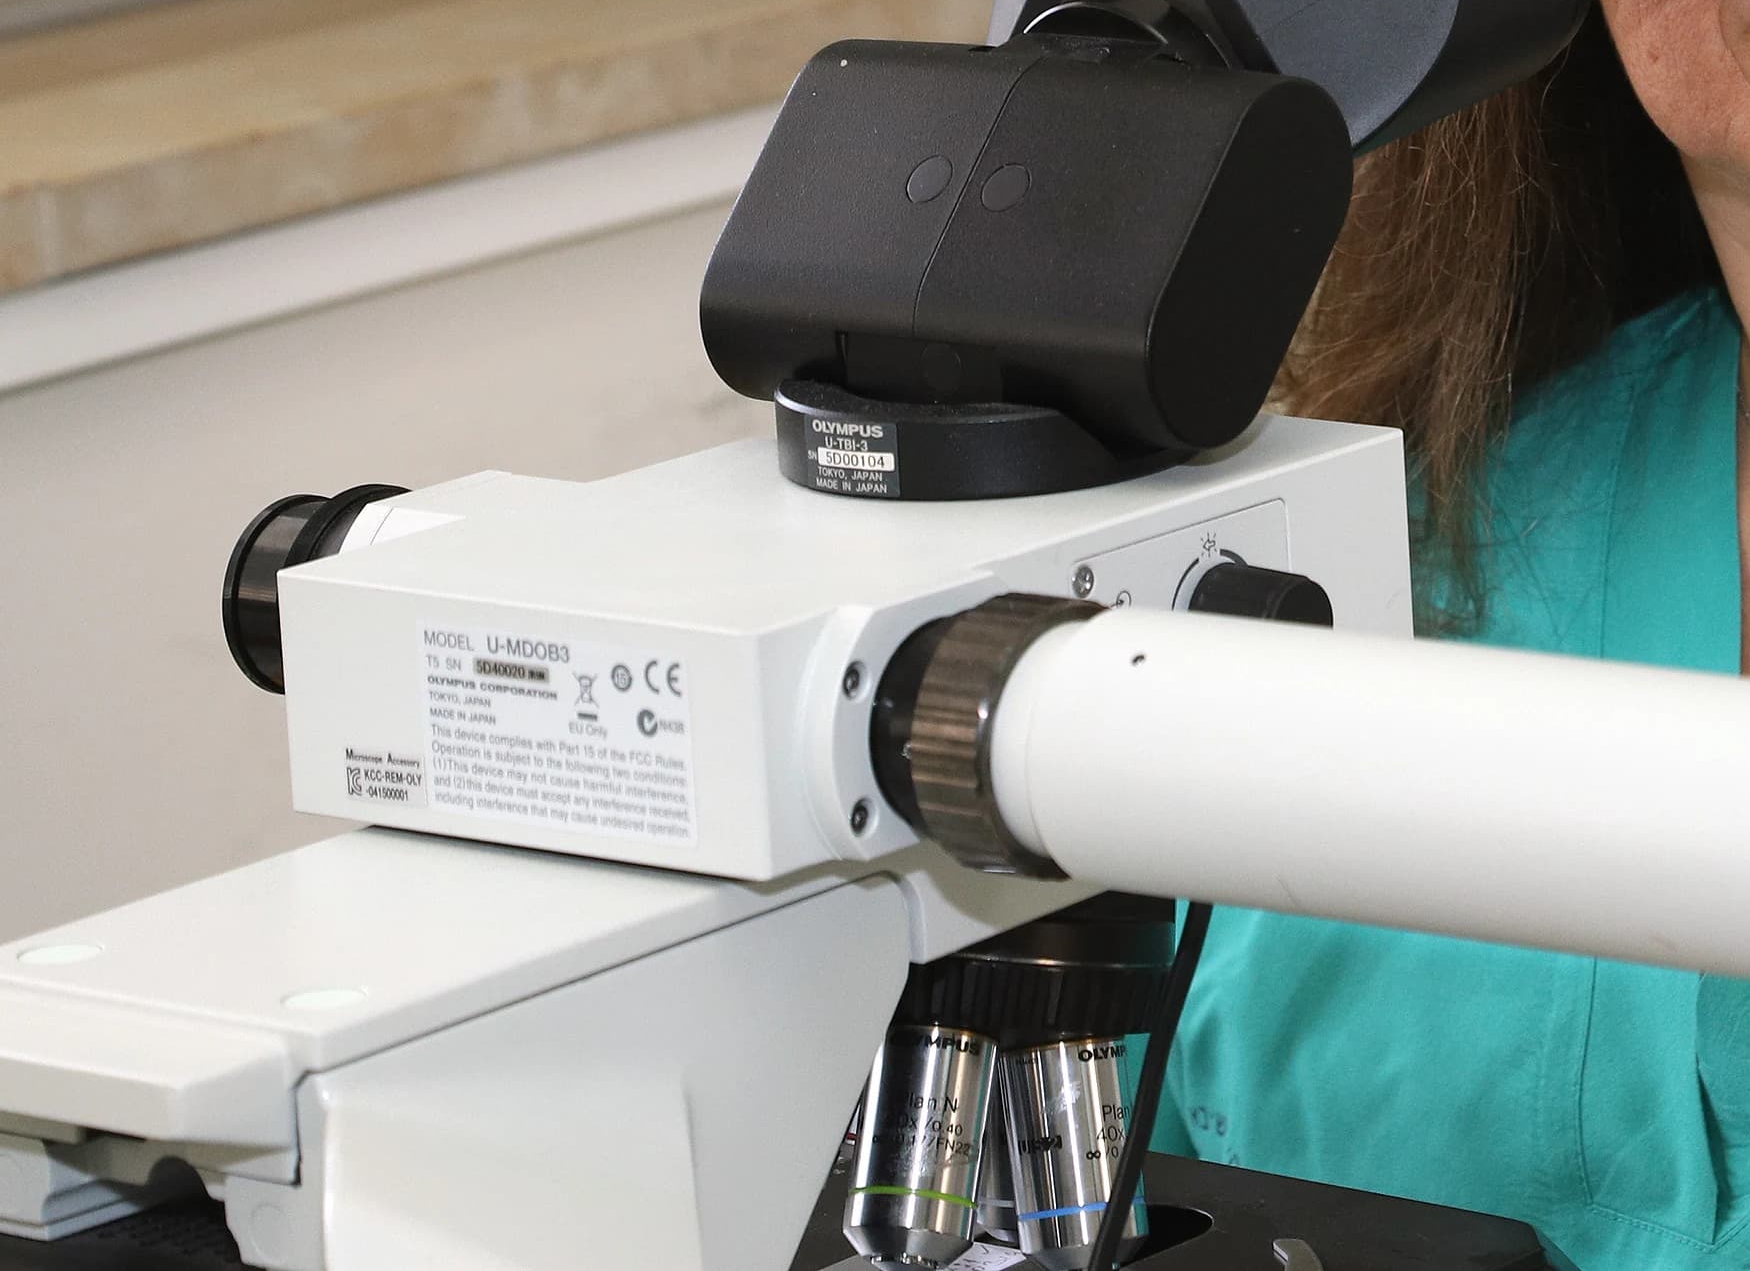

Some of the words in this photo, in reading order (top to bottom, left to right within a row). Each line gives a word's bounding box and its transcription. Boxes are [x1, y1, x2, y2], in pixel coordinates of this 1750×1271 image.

[812, 419, 884, 439] OLYMPUS
[824, 436, 869, 452] U-TBI-3
[826, 451, 885, 468] 5D00104
[817, 466, 848, 480] TOKYO,
[851, 471, 883, 482] JAPAN
[816, 478, 838, 490] MADE
[842, 481, 851, 492] IN
[855, 483, 887, 494] JAPAN
[424, 630, 474, 651] MODEL
[487, 635, 570, 663] U-MDOB3
[427, 675, 476, 690] OLYMPUS
[480, 683, 558, 700] CORPORATION
[463, 696, 491, 708] JAPAN
[429, 708, 455, 720] MADE
[457, 711, 466, 722] IN
[469, 714, 496, 725] JAPAN
[568, 721, 584, 735] EU
[585, 724, 608, 740] Only
[432, 724, 451, 737] This
[455, 728, 486, 742] device
[489, 735, 532, 748] complies
[536, 740, 555, 752] with
[559, 741, 579, 755] Part
[610, 749, 625, 762] the
[387, 752, 420, 769] Accessory
[432, 740, 480, 757] Operation
[484, 749, 492, 760] is
[495, 750, 530, 766] subject
[534, 756, 543, 766] to
[546, 757, 562, 769] the
[565, 759, 609, 778] following
[612, 767, 630, 779] two
[364, 768, 422, 787] KCC-REM-OLY
[472, 763, 504, 778] device
[507, 769, 528, 785] may
[530, 773, 546, 786] not
[549, 776, 580, 789] cause
[583, 777, 622, 794] harmful
[434, 775, 451, 787] and
[485, 780, 514, 795] device
[517, 787, 538, 800] must
[541, 791, 571, 806] accept
[574, 796, 589, 809] any
[435, 791, 474, 810] including
[477, 797, 529, 815] interference
[531, 804, 547, 817] that
[890, 1031, 980, 1056] YMPUS
[1078, 1044, 1127, 1062] OLYMP
